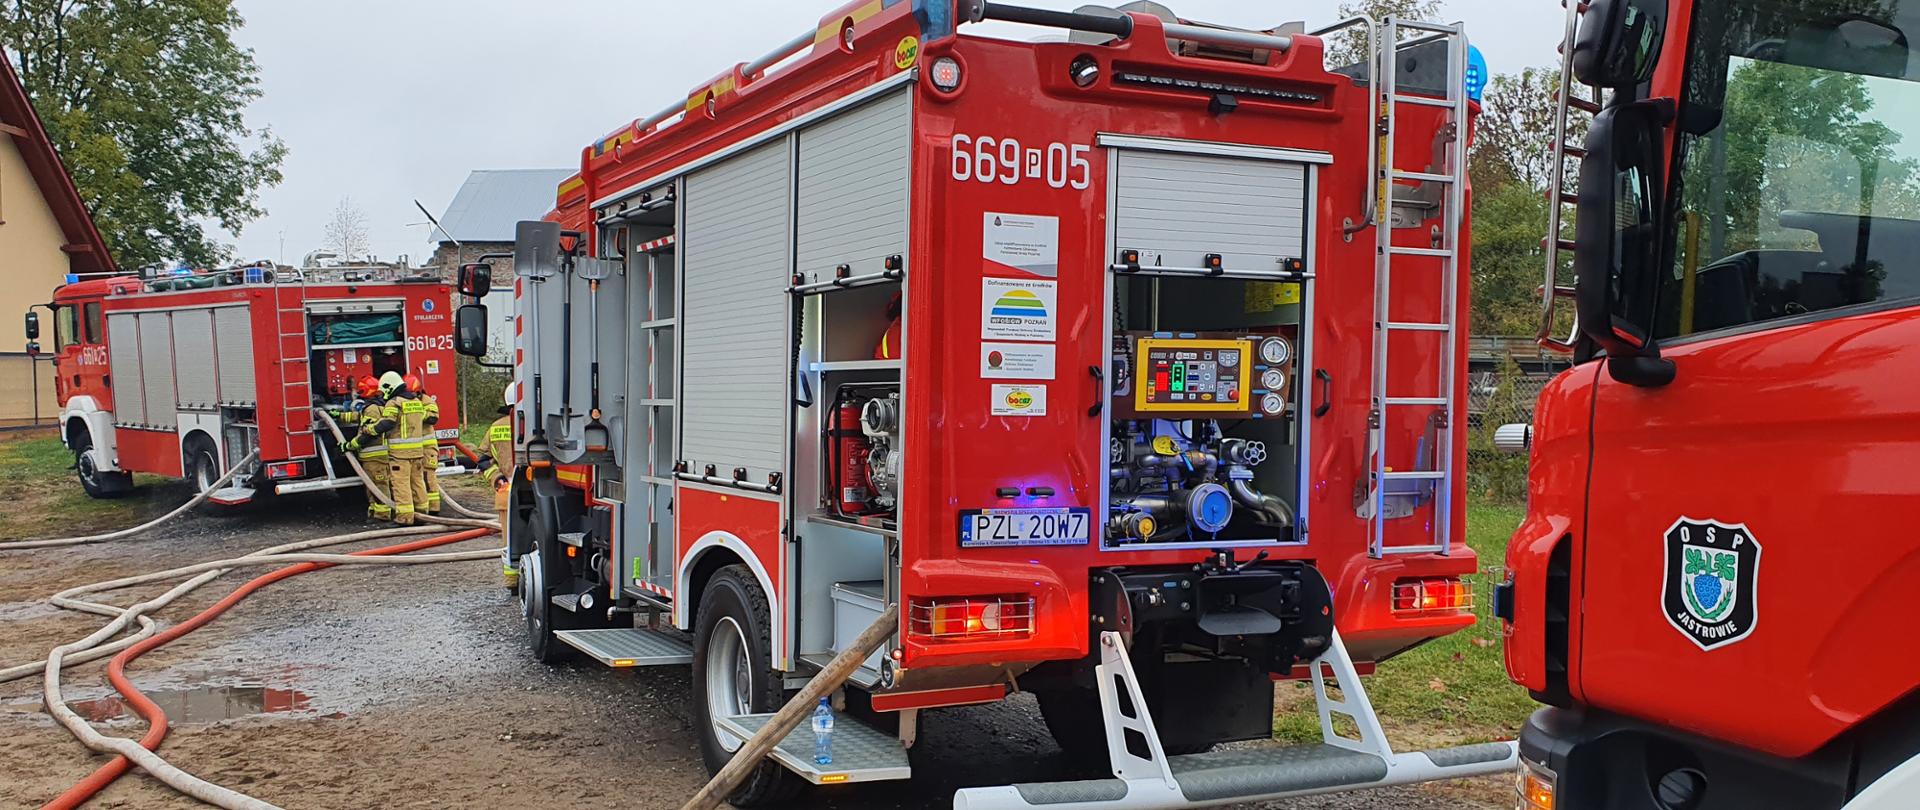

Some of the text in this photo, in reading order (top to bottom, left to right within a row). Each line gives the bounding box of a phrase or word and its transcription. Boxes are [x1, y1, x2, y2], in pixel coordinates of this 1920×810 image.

[408, 336, 429, 351] 661
[437, 335, 454, 350] 25
[977, 514, 1083, 540] PZL 20W7
[1677, 611, 1738, 639] JASTROWIE
